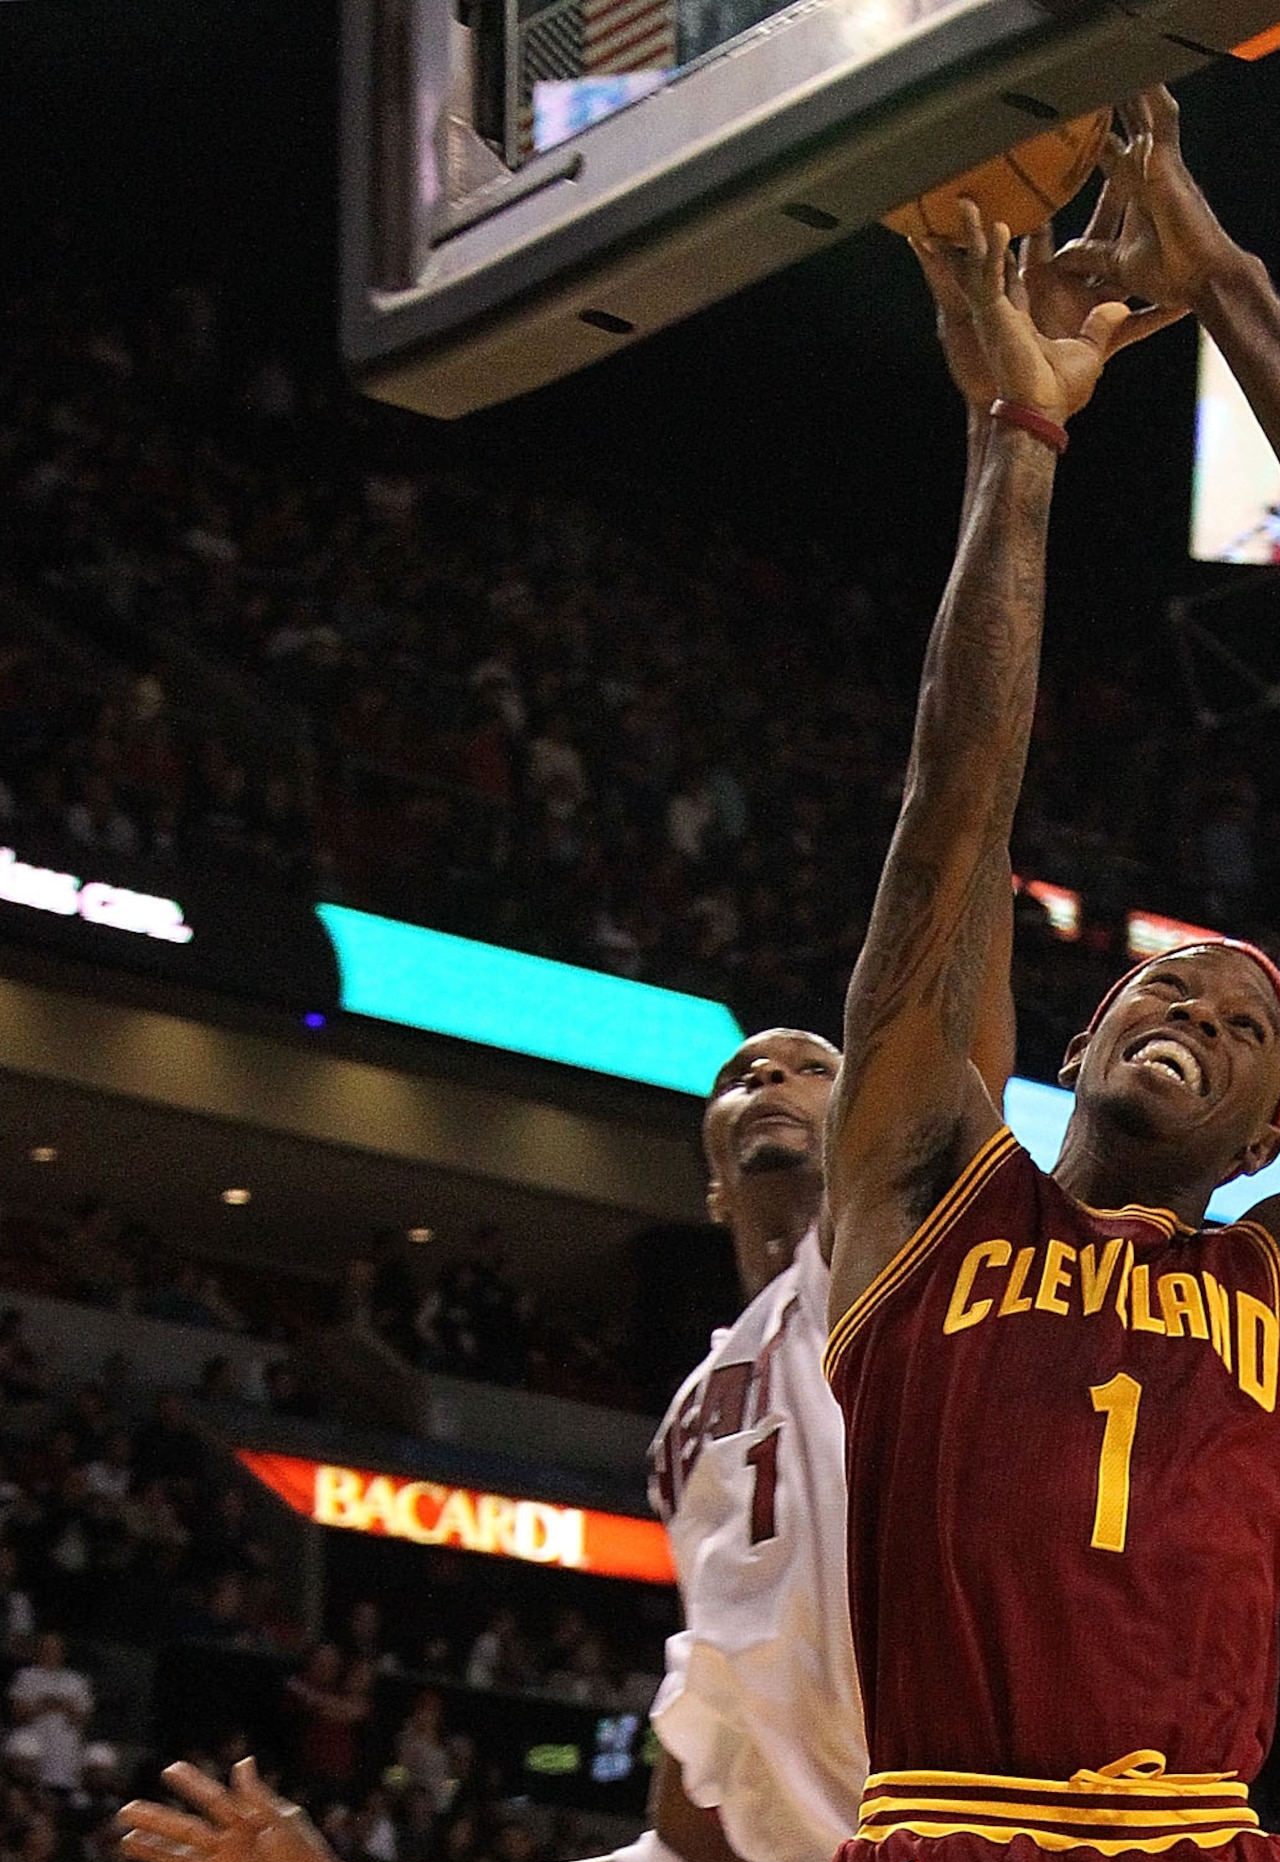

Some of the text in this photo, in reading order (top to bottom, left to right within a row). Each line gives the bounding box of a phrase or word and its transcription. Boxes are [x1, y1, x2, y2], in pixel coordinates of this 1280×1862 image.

[943, 1238, 1280, 1413] CLEVLAND
[313, 1464, 586, 1568] BACARDI
[746, 1427, 780, 1546] 1
[1089, 1372, 1142, 1553] 1
